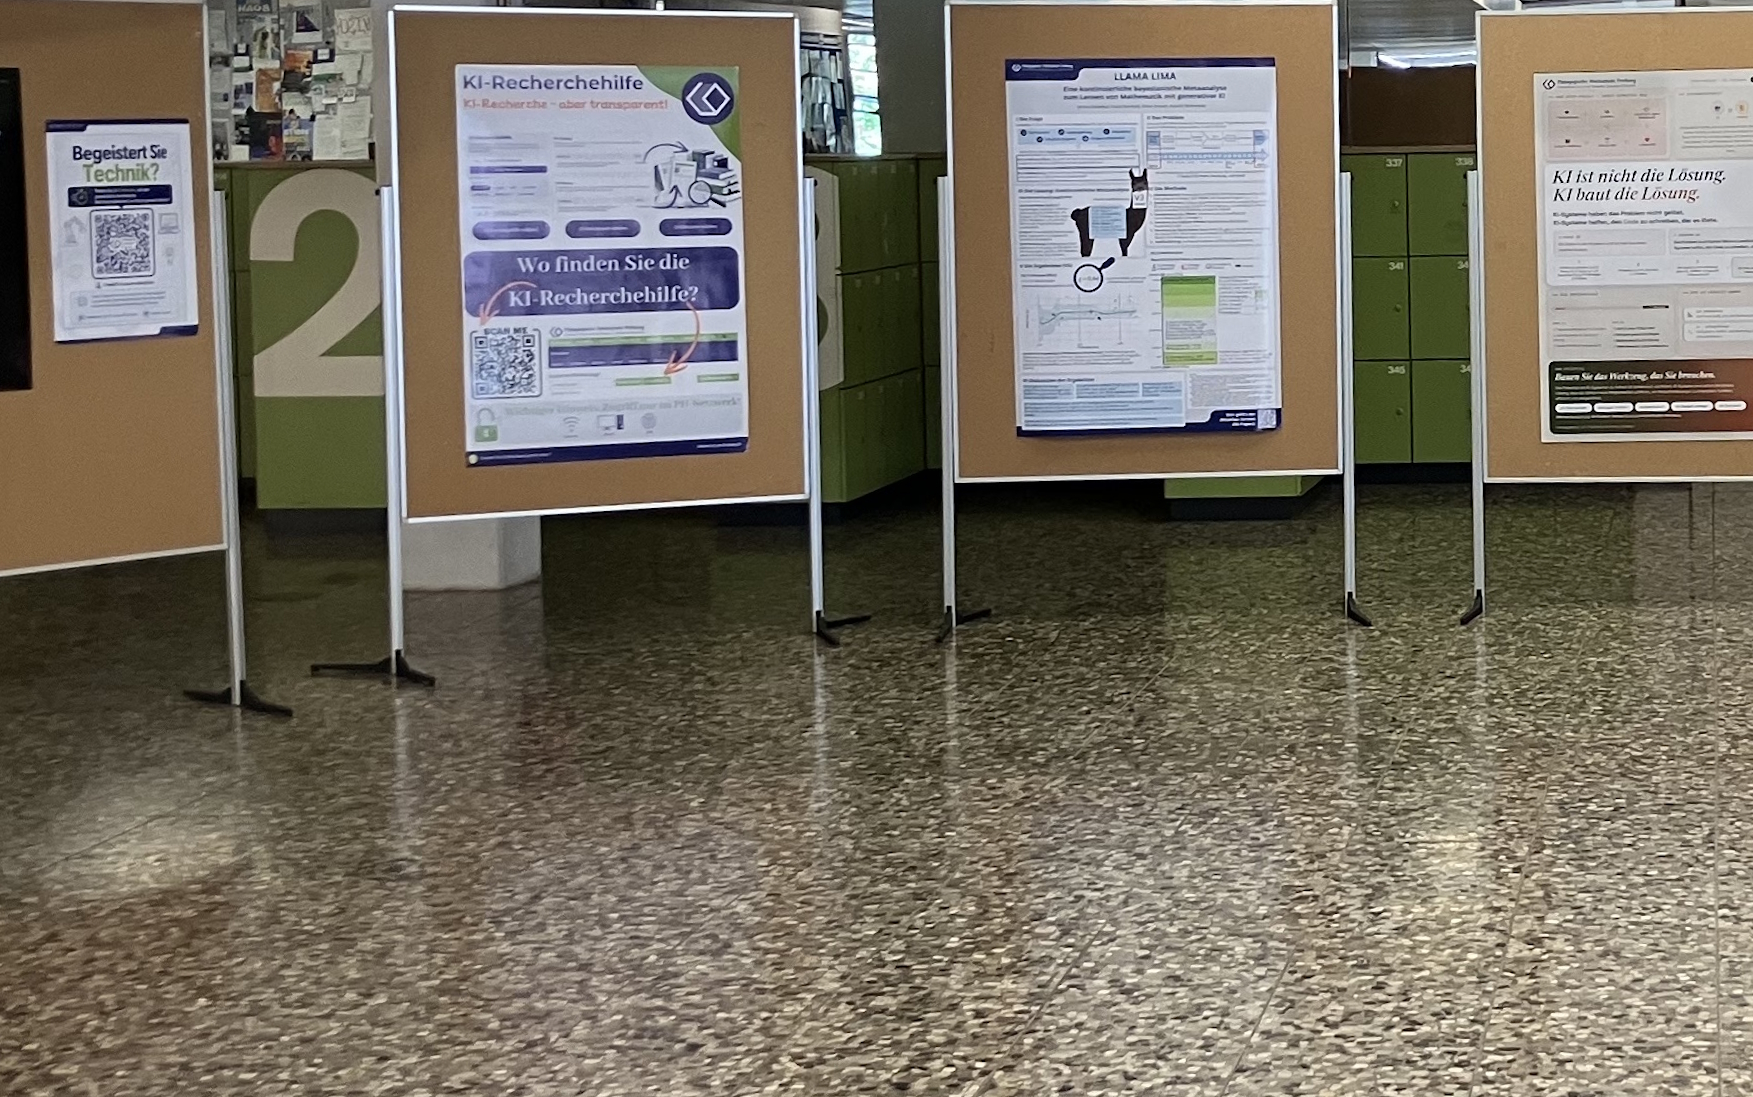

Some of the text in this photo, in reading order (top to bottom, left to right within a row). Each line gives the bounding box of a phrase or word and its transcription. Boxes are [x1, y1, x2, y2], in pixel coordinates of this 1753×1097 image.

[462, 74, 644, 91] KI-Recherchehilfe
[1114, 71, 1177, 81] LLAMA LIMA
[462, 98, 548, 110] KI-Recherche
[558, 97, 588, 110] aber
[589, 97, 669, 111] transparent!
[72, 144, 168, 164] Begeistert Sie
[82, 162, 160, 183] Technik?
[1552, 166, 1727, 185] KI ist nicht die Lösung.
[1552, 184, 1701, 203] KI baut die Lösung.
[516, 253, 690, 274] Wo finden Sie die
[249, 168, 384, 397] 2
[508, 285, 699, 308] KI-Recherchehilfe?
